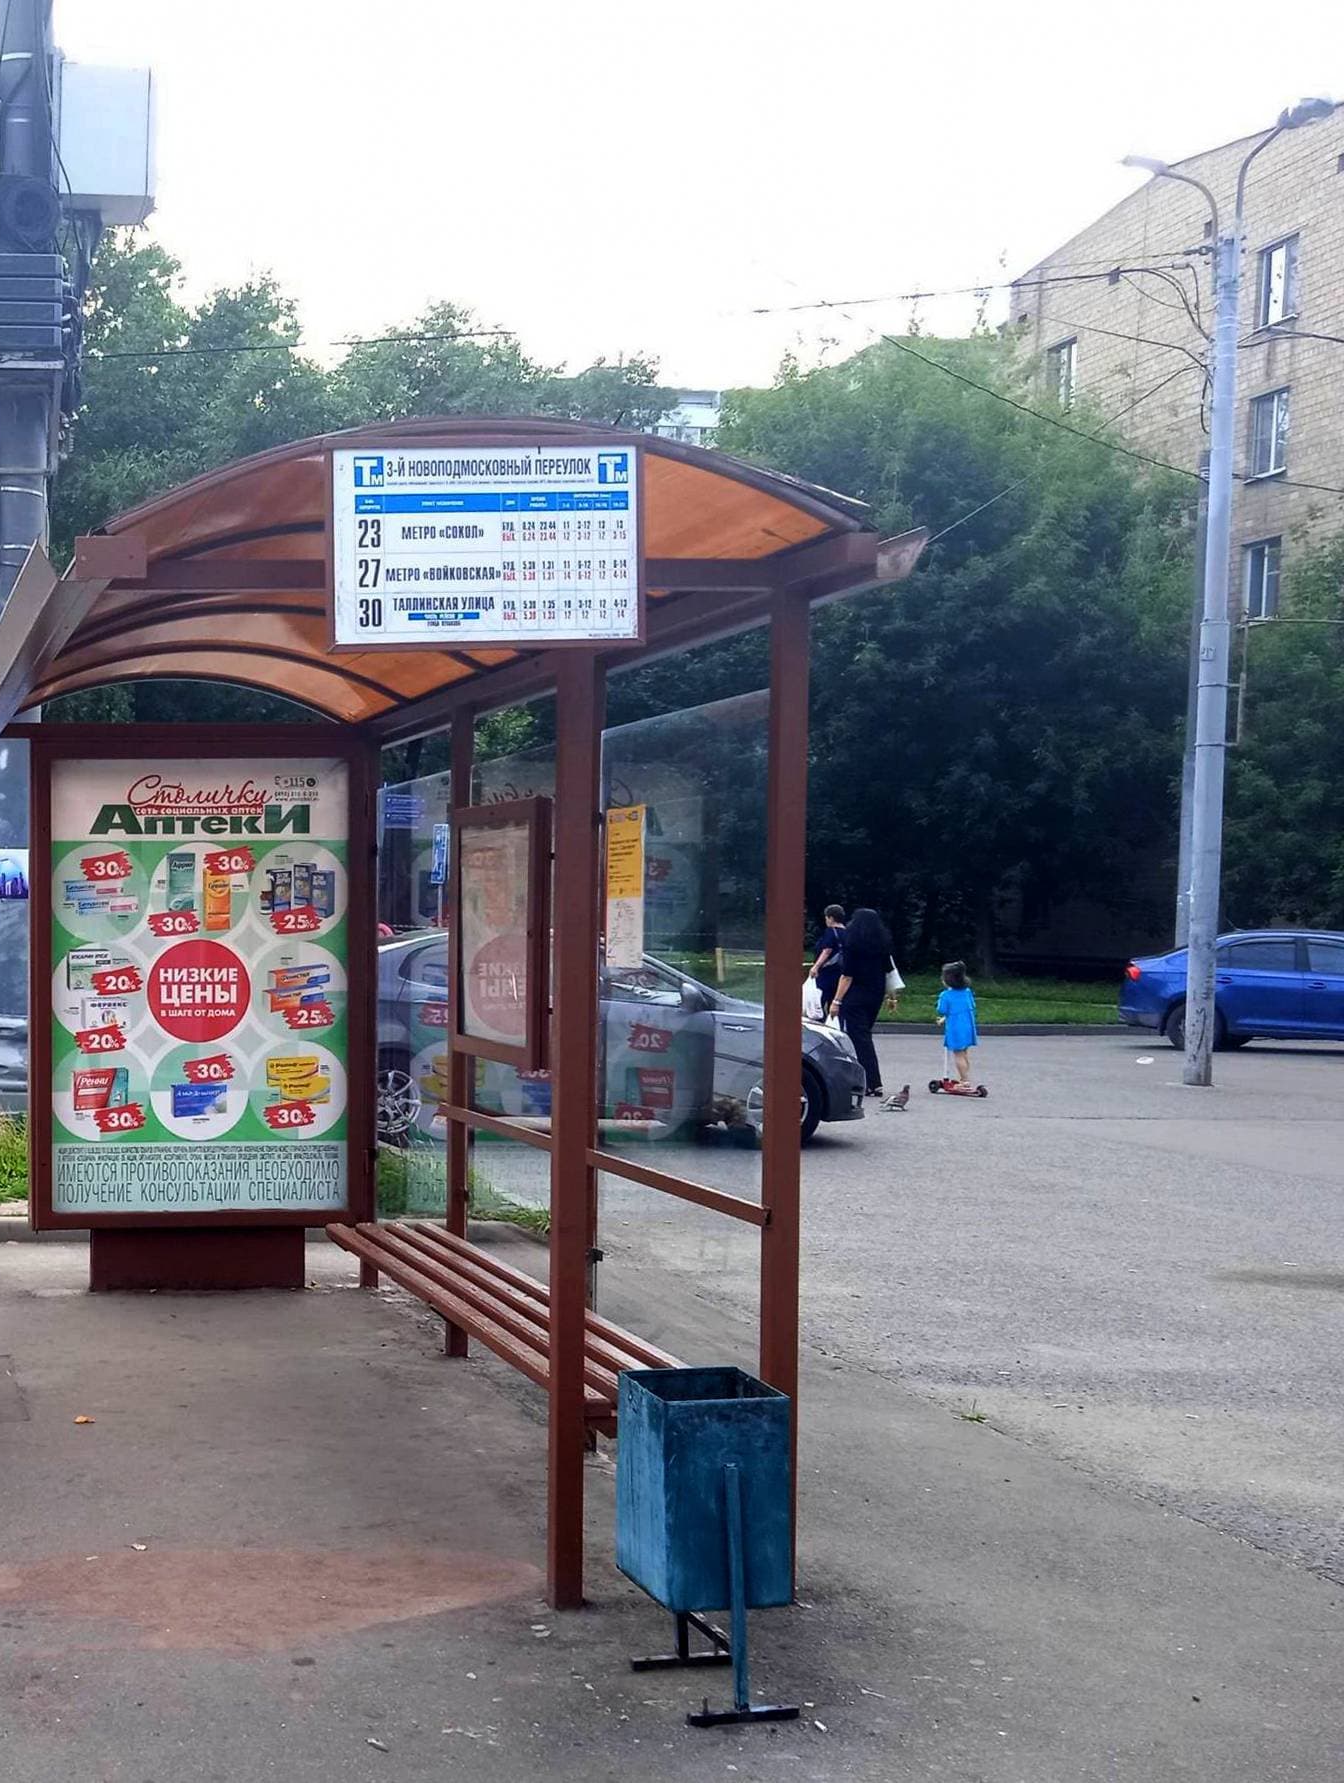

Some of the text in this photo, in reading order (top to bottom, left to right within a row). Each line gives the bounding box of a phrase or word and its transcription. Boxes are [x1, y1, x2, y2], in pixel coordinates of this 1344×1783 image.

[386, 455, 592, 479] 3-Й НОВОПОДМОСКОВНЫЙ ПЕРЕУЛОК
[358, 519, 381, 548] 23
[401, 525, 484, 540] МЕТРО «СОКОЛ»
[358, 558, 381, 588] 27
[385, 565, 501, 582] МЕТРО «ВОЙКОВСКАЯ»
[359, 598, 383, 628] 30
[392, 597, 495, 612] ТАЛЛИНСКАЯ УЛИЦА
[127, 774, 273, 805] Столички
[136, 806, 263, 816] сеть социальных аптек
[159, 967, 238, 982] НИЗКИЕ
[160, 984, 237, 1007] ЦЕНЫ
[160, 1009, 236, 1018] В ШАГЕ ОТ ДОМА
[57, 1160, 340, 1183] ИМЕЮТСЯ ПРОТИВОПОКАЗАНИЯ. НЕОБХОДИМО
[57, 1181, 340, 1204] ПОЛУЧЕНИЕ КОНСУЛЬТАЦИИ СПЕЦИАЛИСТА
